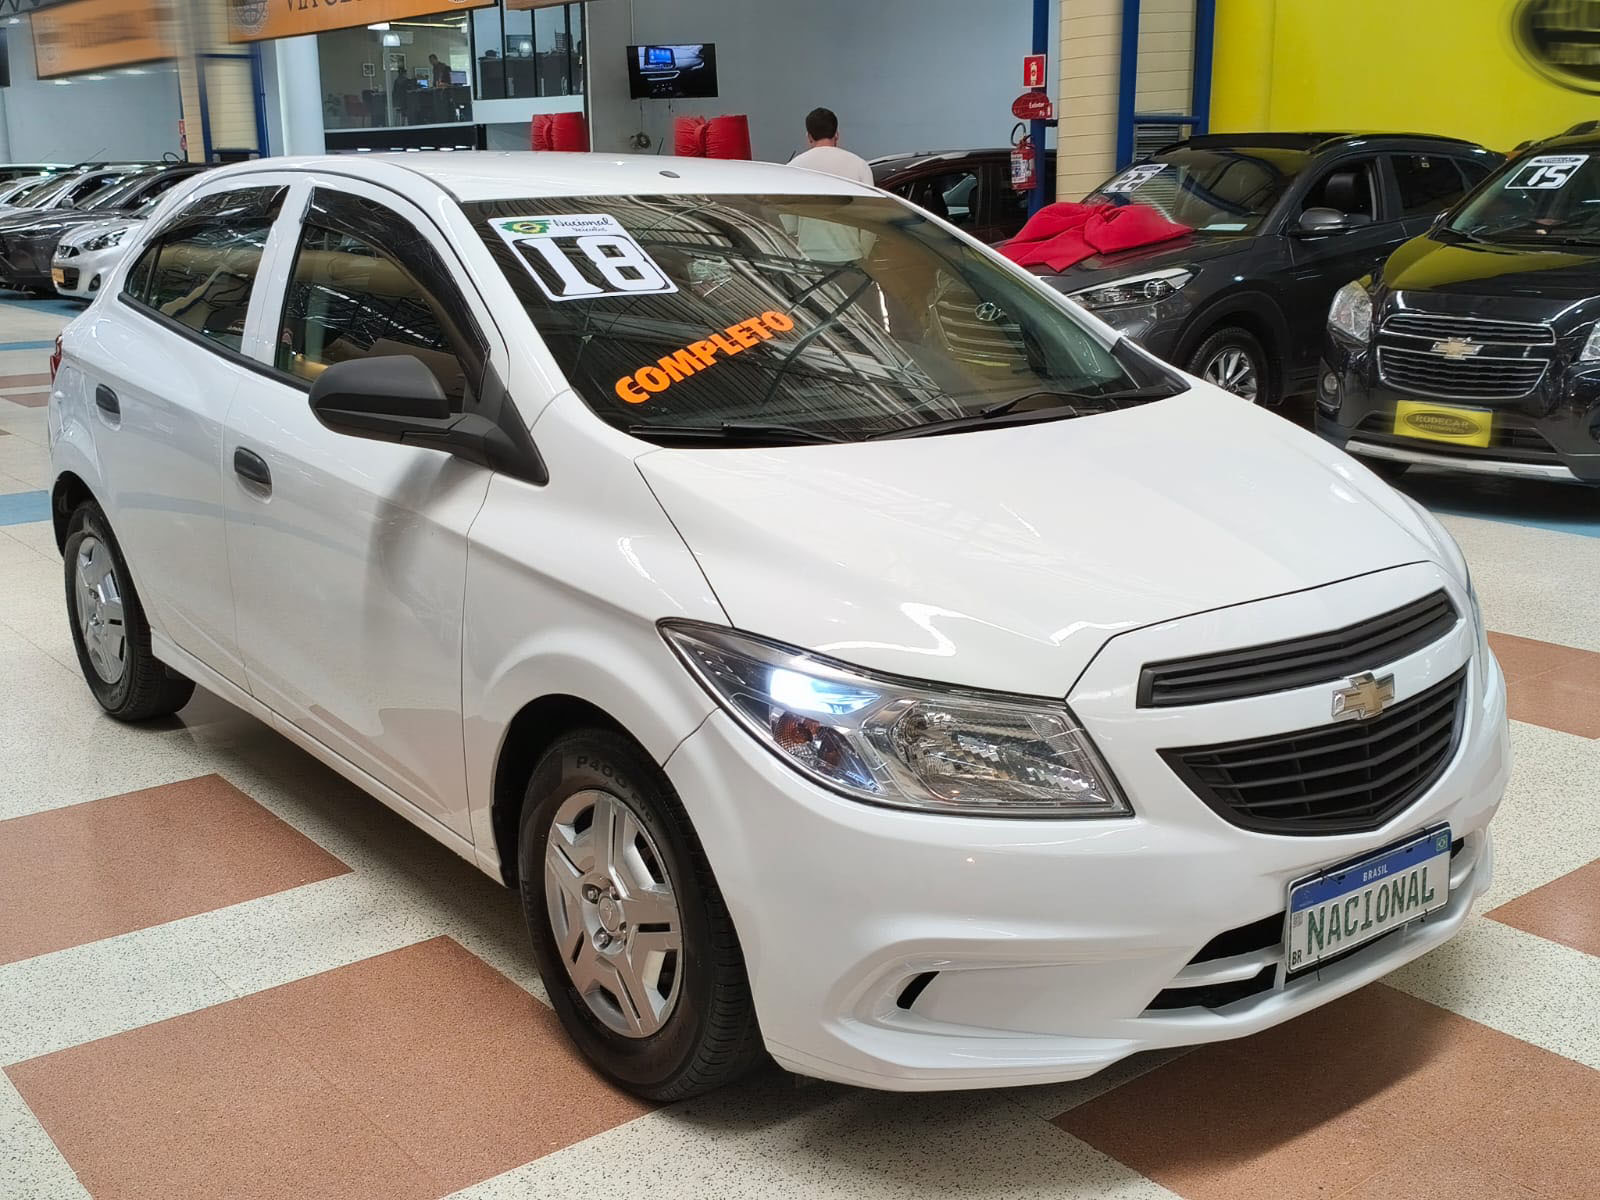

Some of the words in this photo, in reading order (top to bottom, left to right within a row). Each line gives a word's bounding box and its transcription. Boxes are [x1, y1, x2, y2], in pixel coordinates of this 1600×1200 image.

[1527, 165, 1572, 187] 15
[520, 235, 666, 296] 18
[615, 311, 794, 404] COMPLETO
[1415, 415, 1469, 429] RODECAR
[1363, 864, 1388, 882] BRASIL
[1307, 866, 1434, 955] NACIONAL
[1292, 950, 1302, 966] BR
